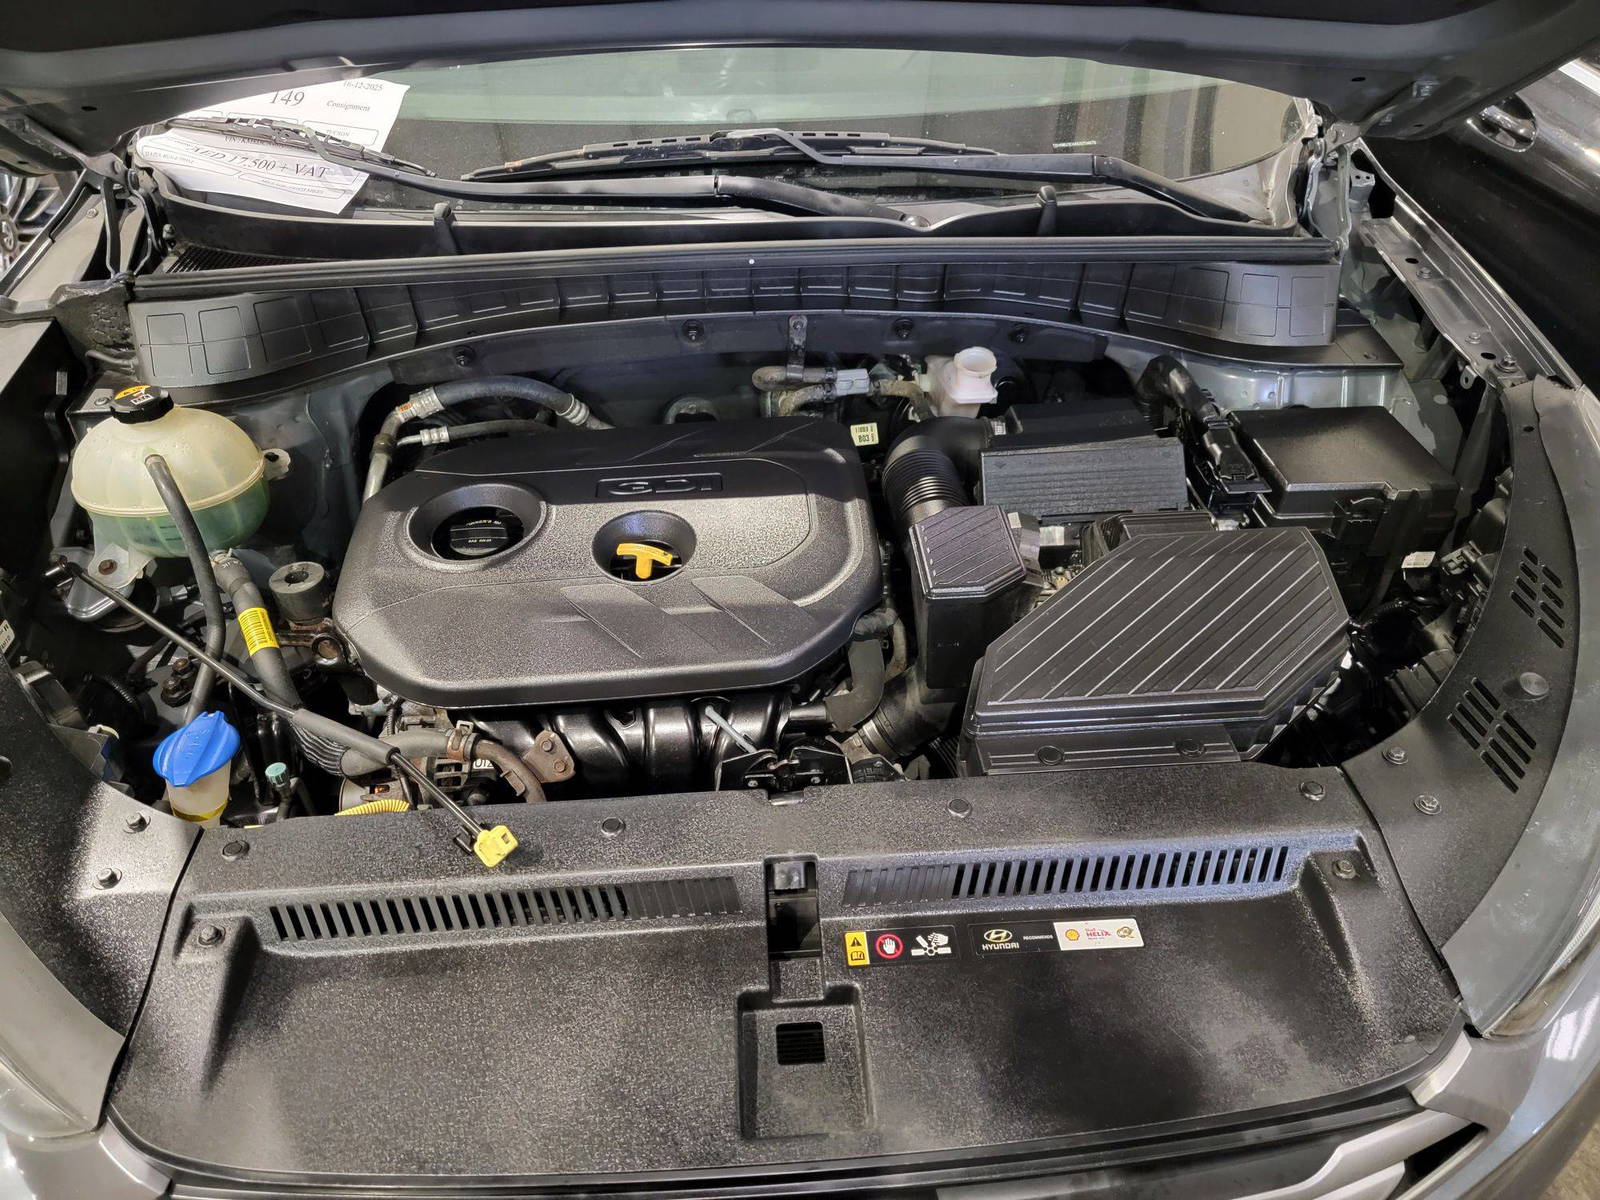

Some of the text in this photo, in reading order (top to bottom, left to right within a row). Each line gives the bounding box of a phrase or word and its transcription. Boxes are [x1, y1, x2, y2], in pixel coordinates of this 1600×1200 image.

[270, 91, 305, 107] 149
[326, 100, 371, 112] Consignment
[294, 163, 330, 177] VAT
[982, 942, 1020, 951] HYUNDAI
